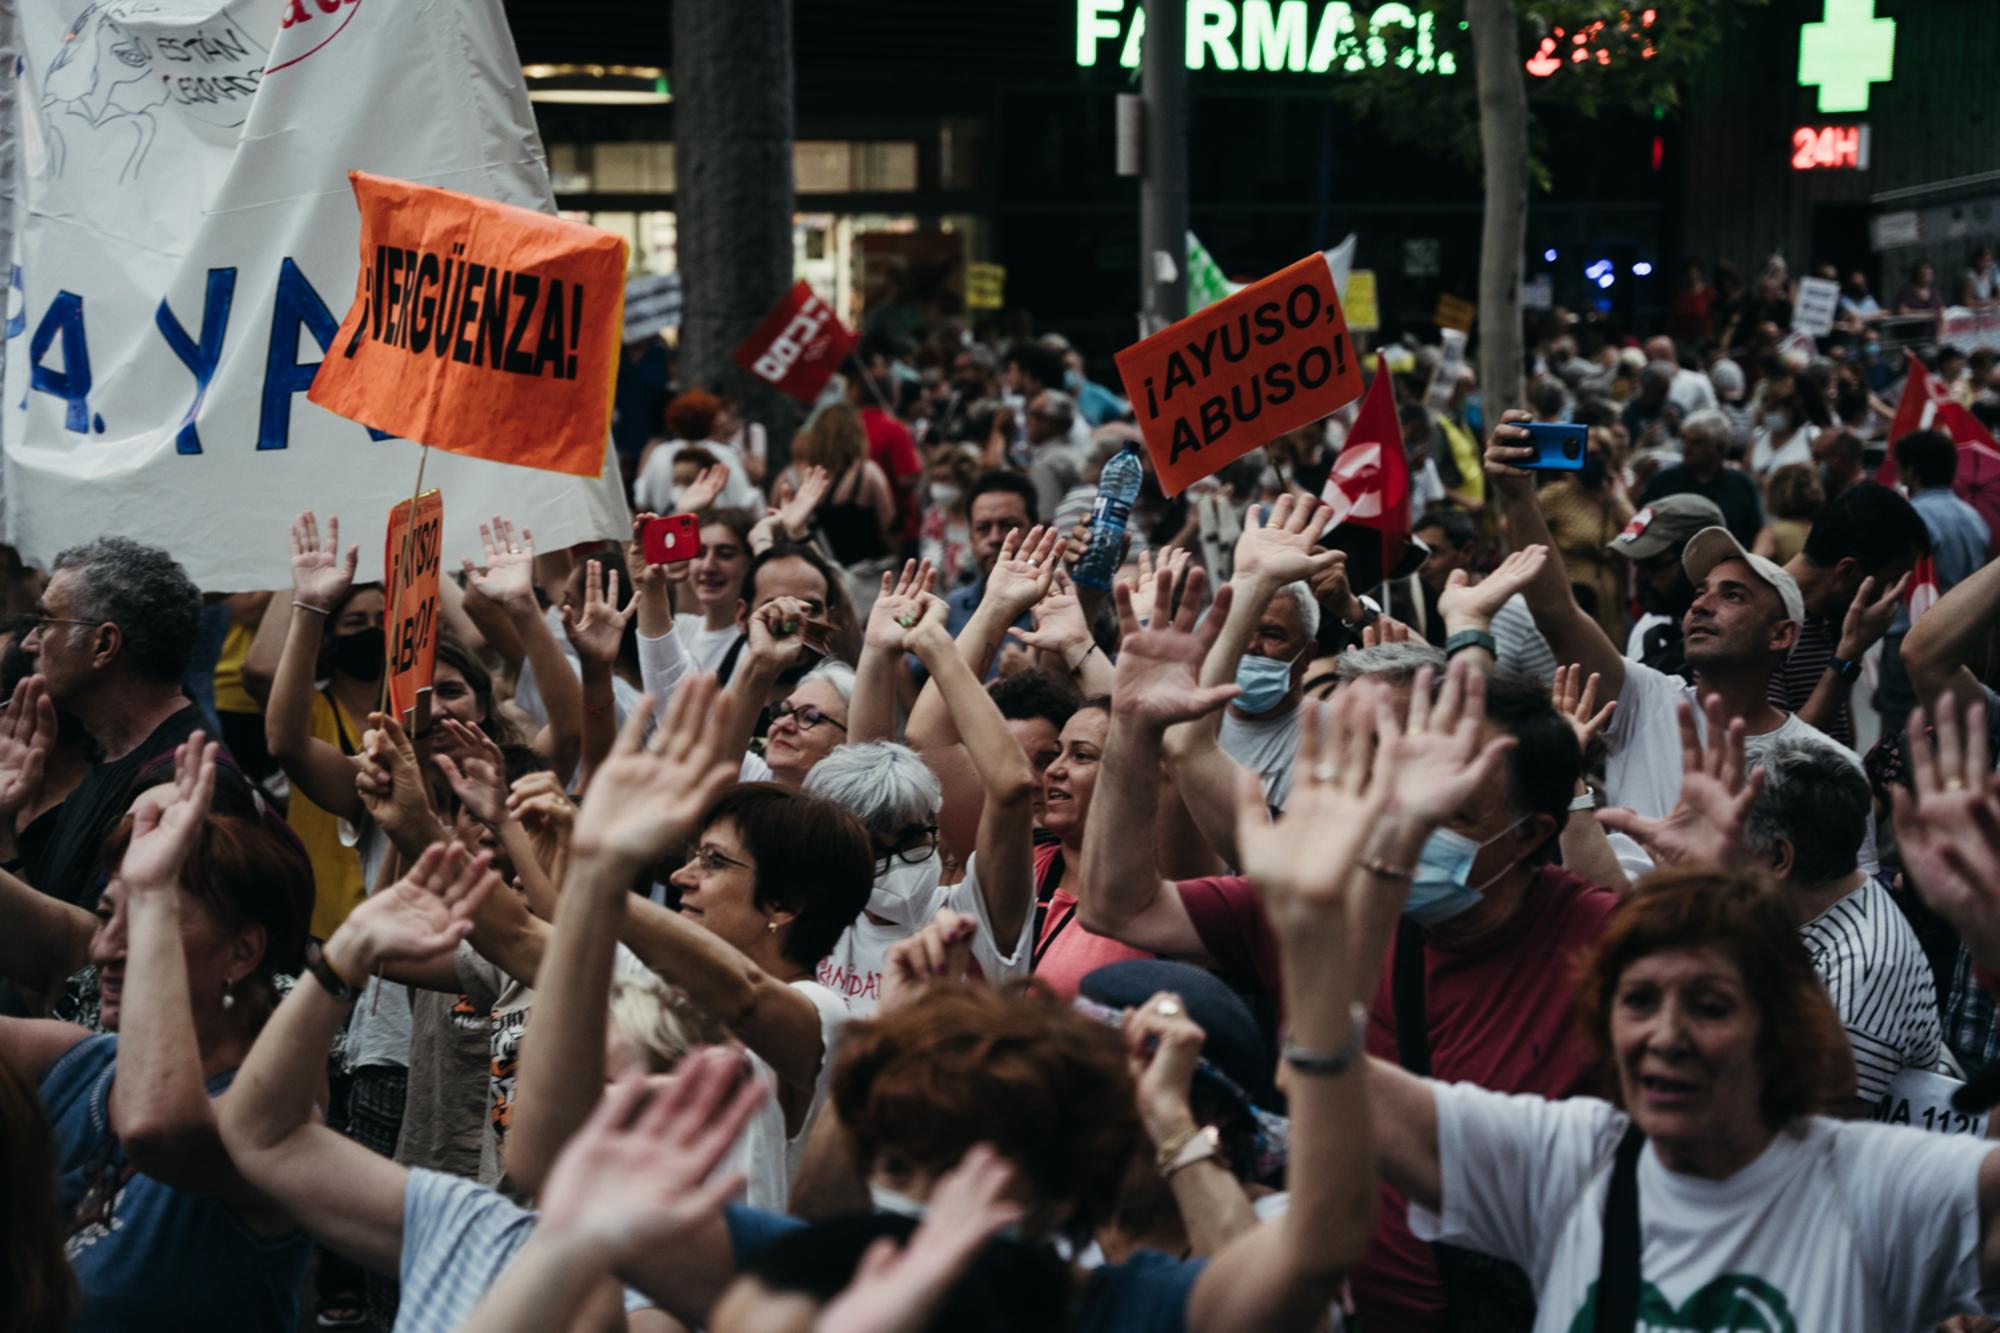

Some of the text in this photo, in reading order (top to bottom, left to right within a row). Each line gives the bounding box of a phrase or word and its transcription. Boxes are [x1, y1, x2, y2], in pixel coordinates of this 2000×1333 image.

[1077, 0, 1457, 74] FRMACI
[1793, 126, 1859, 169] 24H
[343, 241, 584, 380] ¡VERGÜENZA!
[1144, 284, 1335, 420] ¡AYUSO,
[1168, 332, 1346, 465] ABUSO!
